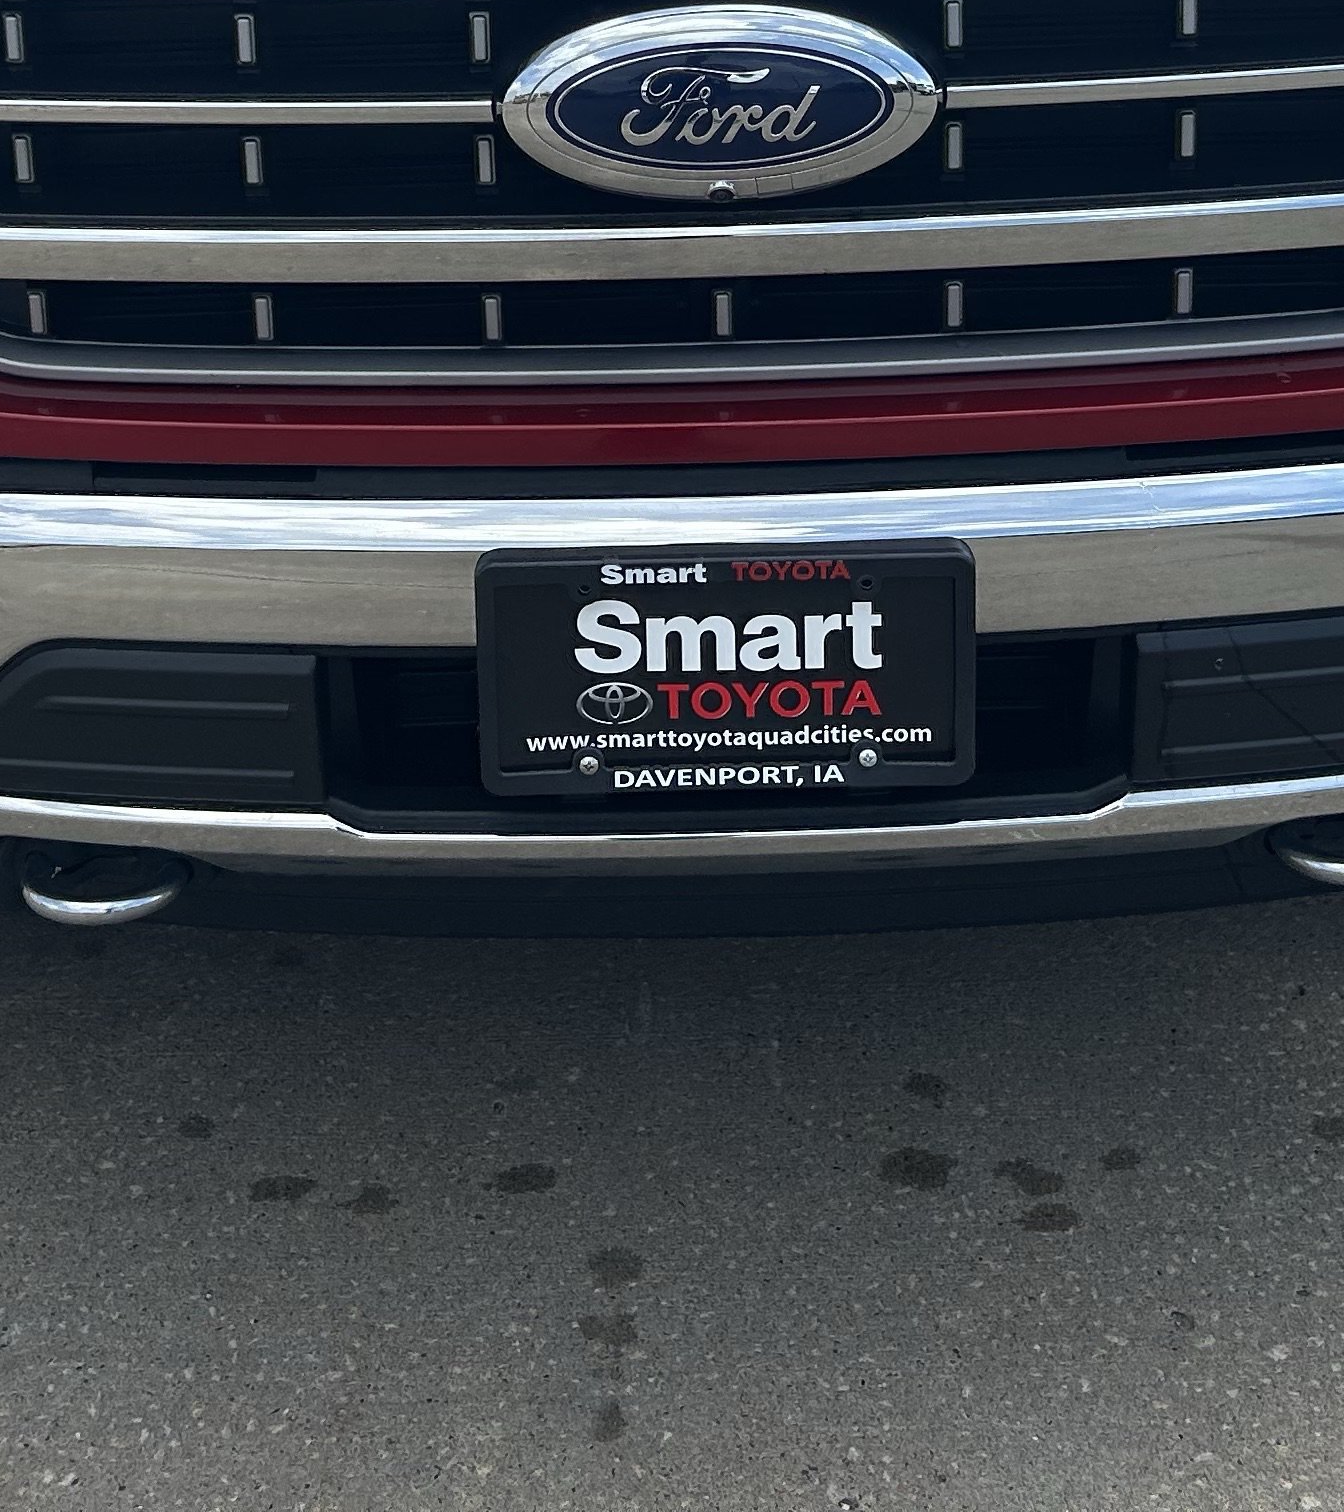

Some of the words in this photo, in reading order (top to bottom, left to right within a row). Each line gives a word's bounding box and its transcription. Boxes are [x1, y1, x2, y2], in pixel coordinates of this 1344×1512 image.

[621, 67, 820, 146] Ford
[601, 563, 707, 584] Smart
[731, 561, 851, 582] TOYOTA
[574, 599, 883, 673] Smart
[658, 680, 881, 719] TOYOTA
[526, 725, 932, 752] www.smarttoyotaquadcities.com
[613, 765, 804, 788] DAVENPORT,
[813, 764, 845, 783] IA
